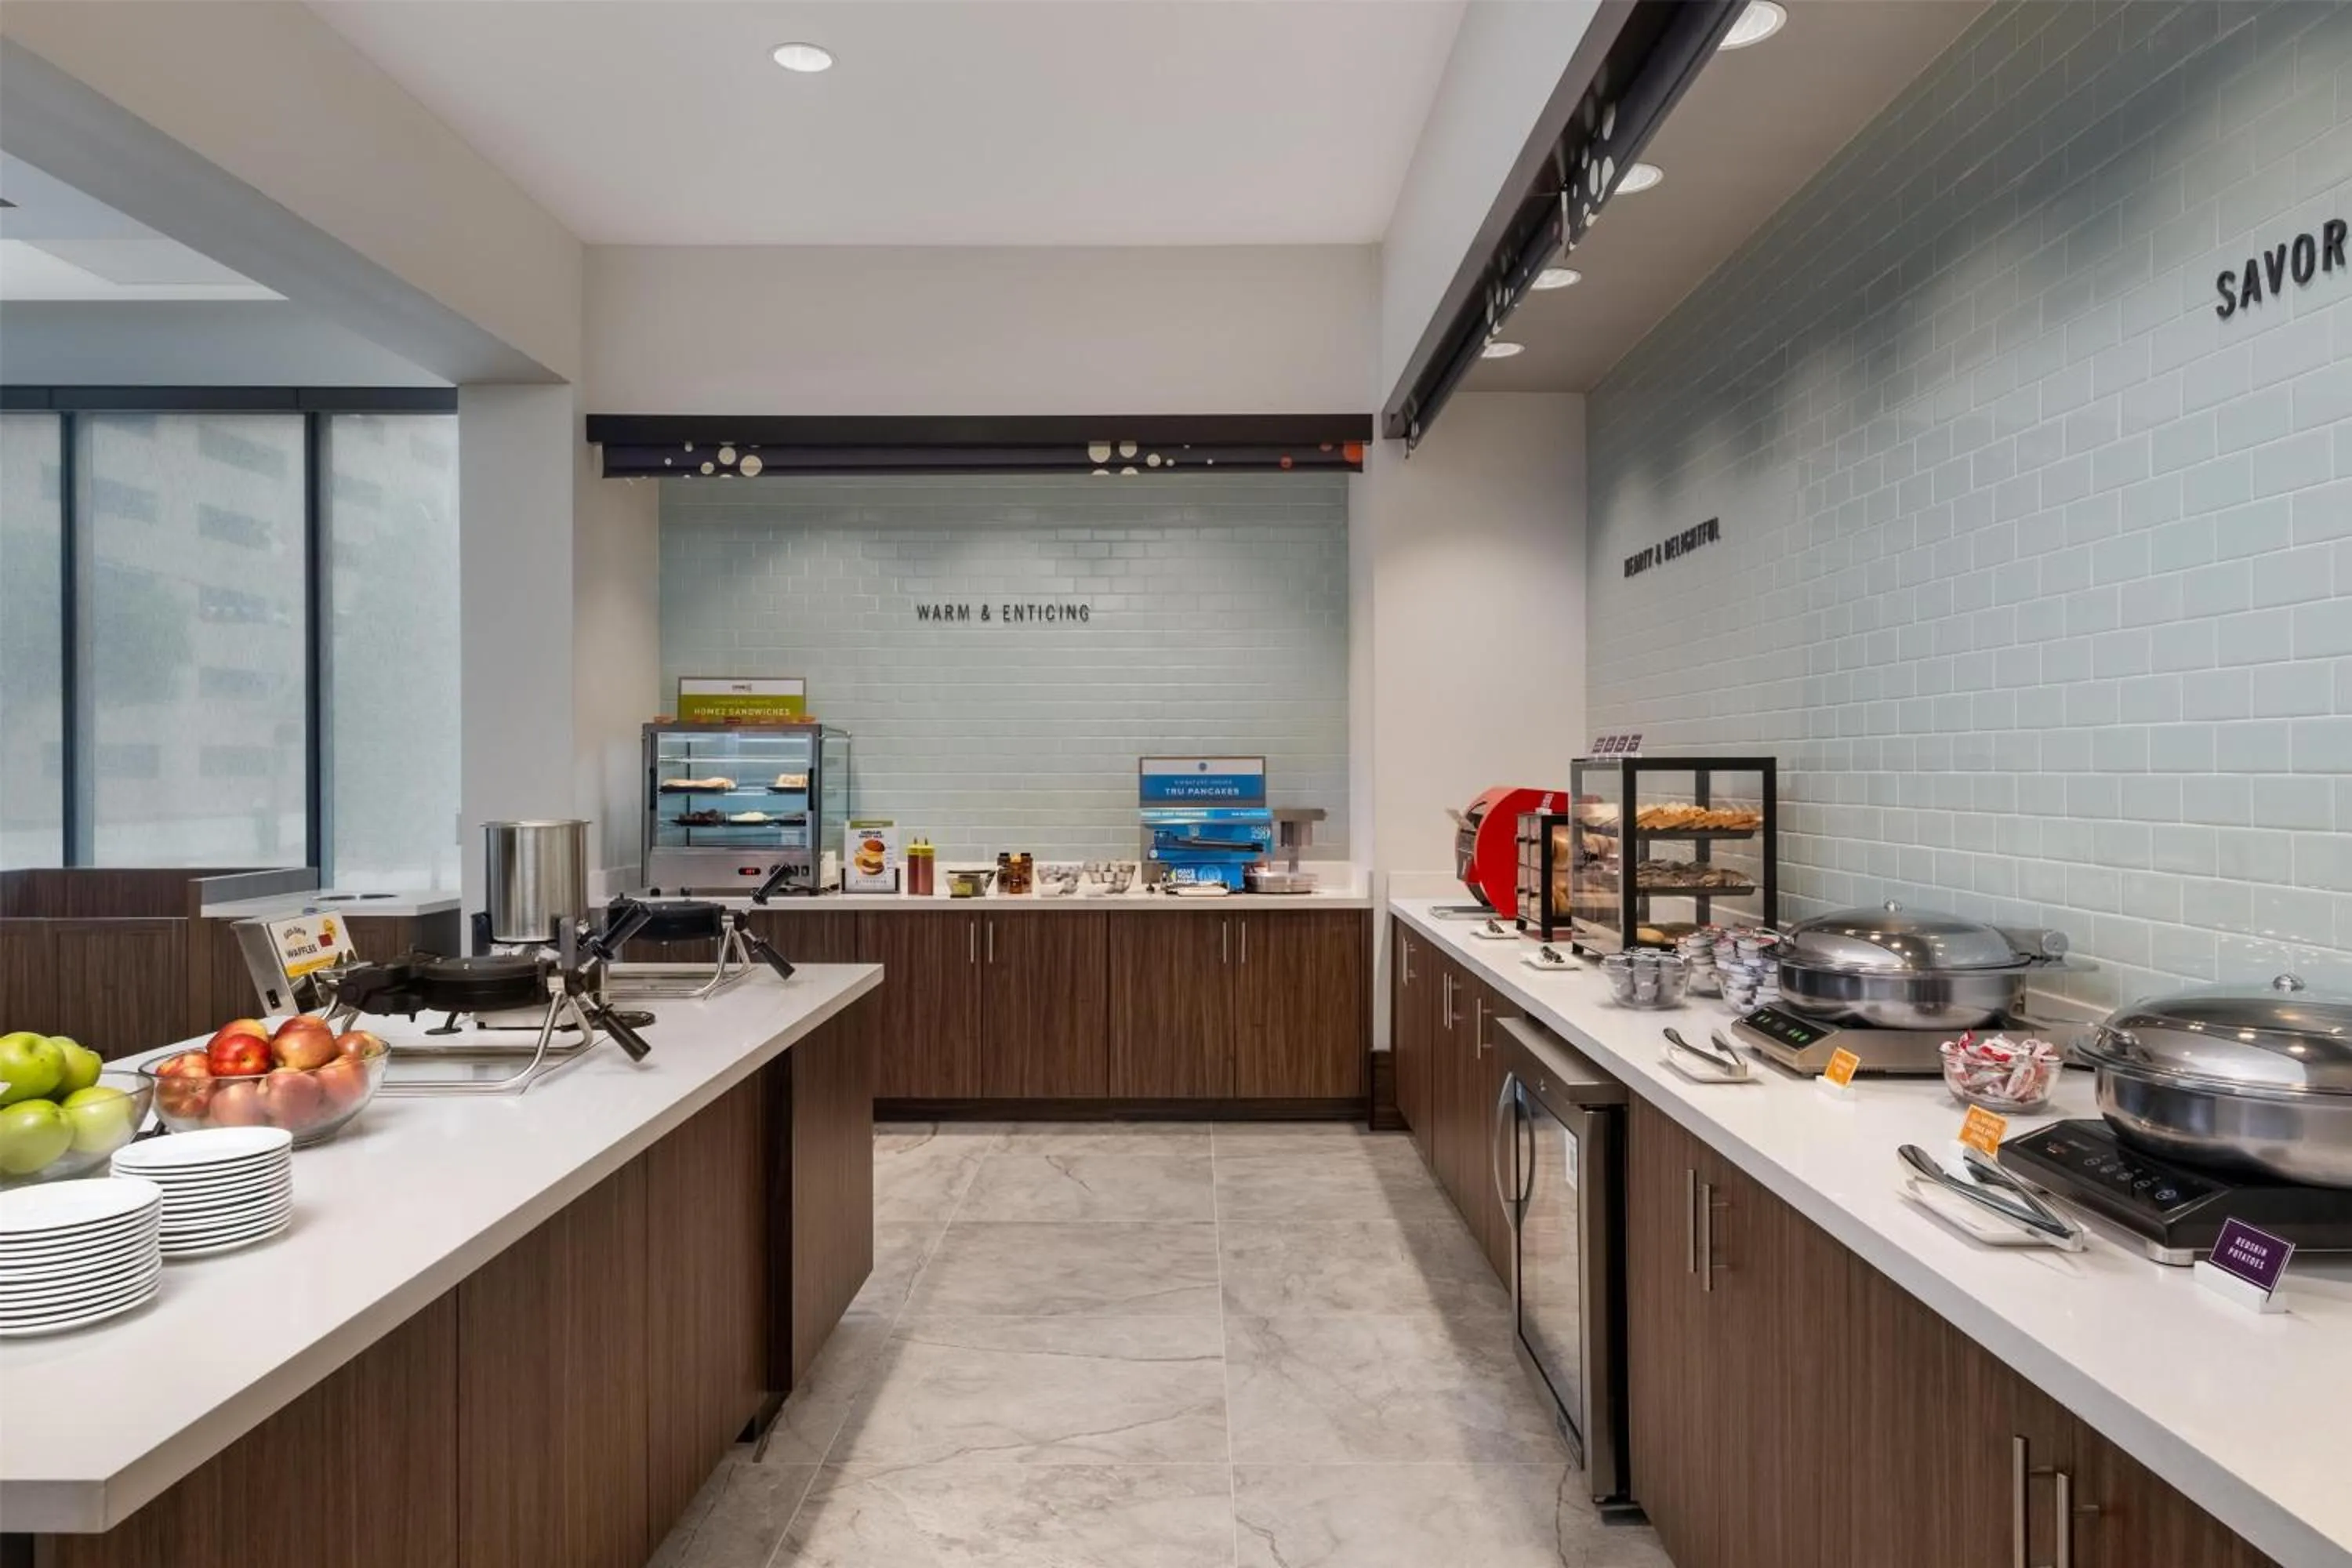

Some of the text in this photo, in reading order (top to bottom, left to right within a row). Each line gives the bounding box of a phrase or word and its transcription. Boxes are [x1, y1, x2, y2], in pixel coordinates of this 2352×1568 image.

[2216, 219, 2347, 320] SAVOR
[1656, 543, 1662, 565] &
[1664, 517, 1721, 561] DELIGHTFUL
[916, 604, 1091, 622] WARM & ENTICING
[728, 707, 791, 717] SANDWICHES
[1165, 787, 1240, 797] TRU PANCAKES
[285, 943, 318, 958] WAFFLES
[2234, 1236, 2268, 1258] REDSKIN
[2227, 1247, 2266, 1269] POTATOES
